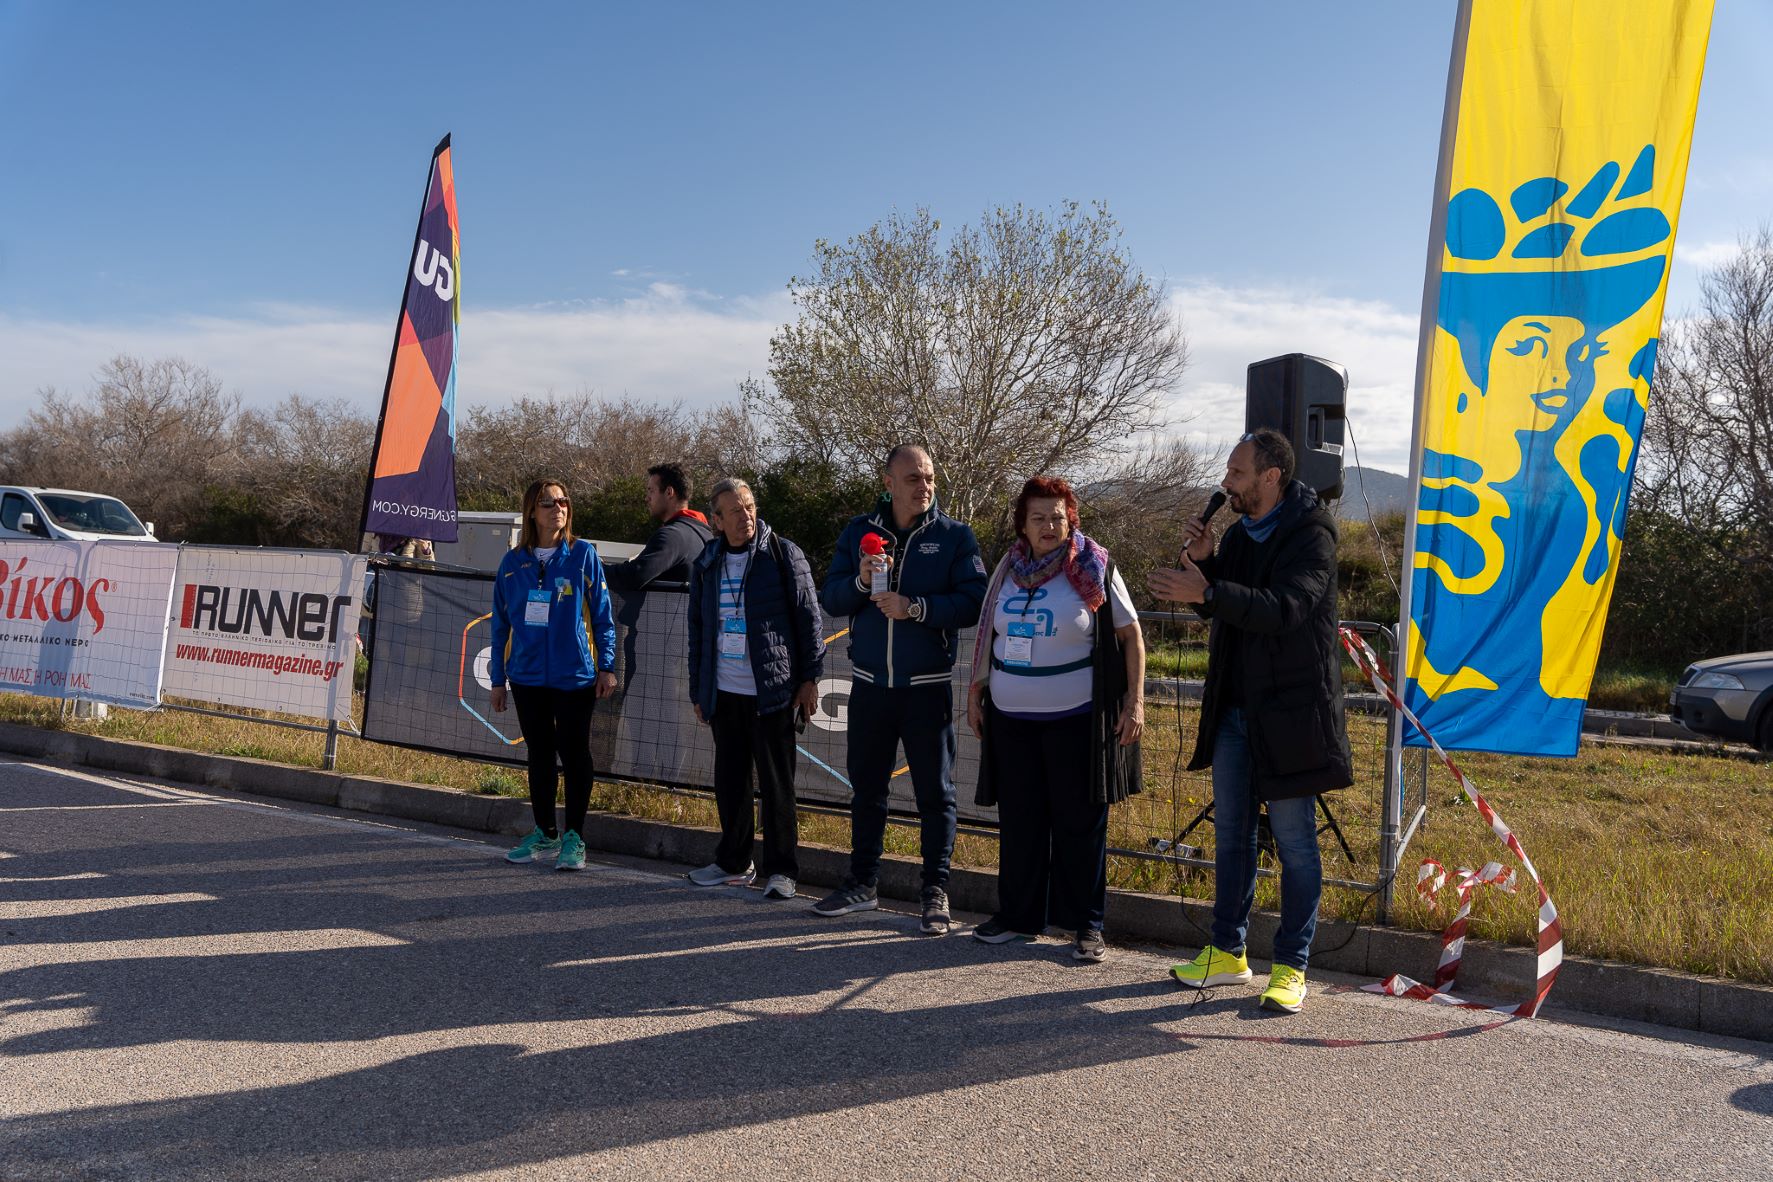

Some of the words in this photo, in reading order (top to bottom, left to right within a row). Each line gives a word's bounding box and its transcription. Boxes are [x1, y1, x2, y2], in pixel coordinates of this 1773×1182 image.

[12, 634, 61, 646] ΜΕΤΑΛΛΙΚΟ
[176, 643, 345, 682] www.runnermagazine.gr
[44, 669, 68, 688] ΡΟΗ
